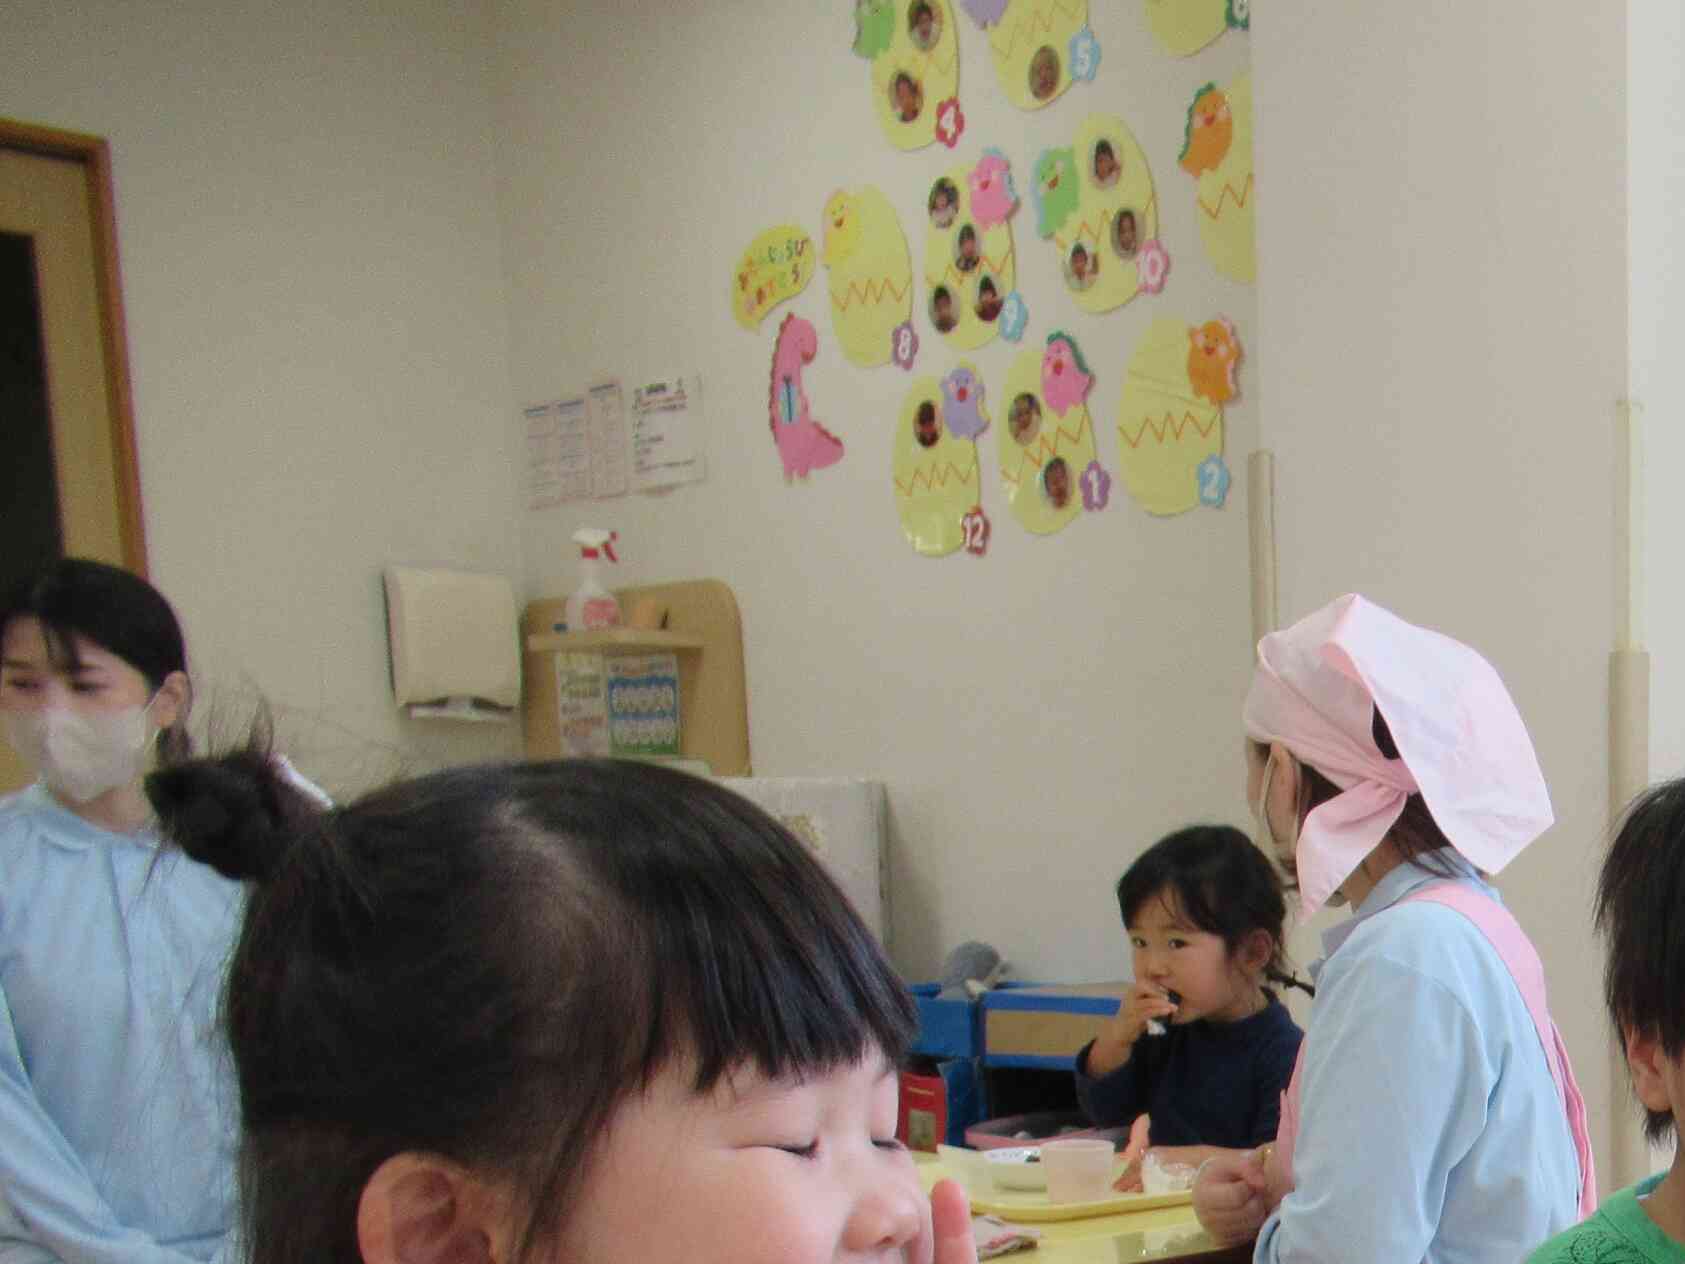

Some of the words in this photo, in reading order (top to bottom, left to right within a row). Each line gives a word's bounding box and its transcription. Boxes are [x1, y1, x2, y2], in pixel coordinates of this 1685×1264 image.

[940, 105, 956, 140] 4
[1140, 248, 1163, 284] 10
[897, 328, 912, 356] 8
[1089, 466, 1102, 505] 1
[1203, 461, 1221, 501] 2
[962, 510, 987, 549] 12
